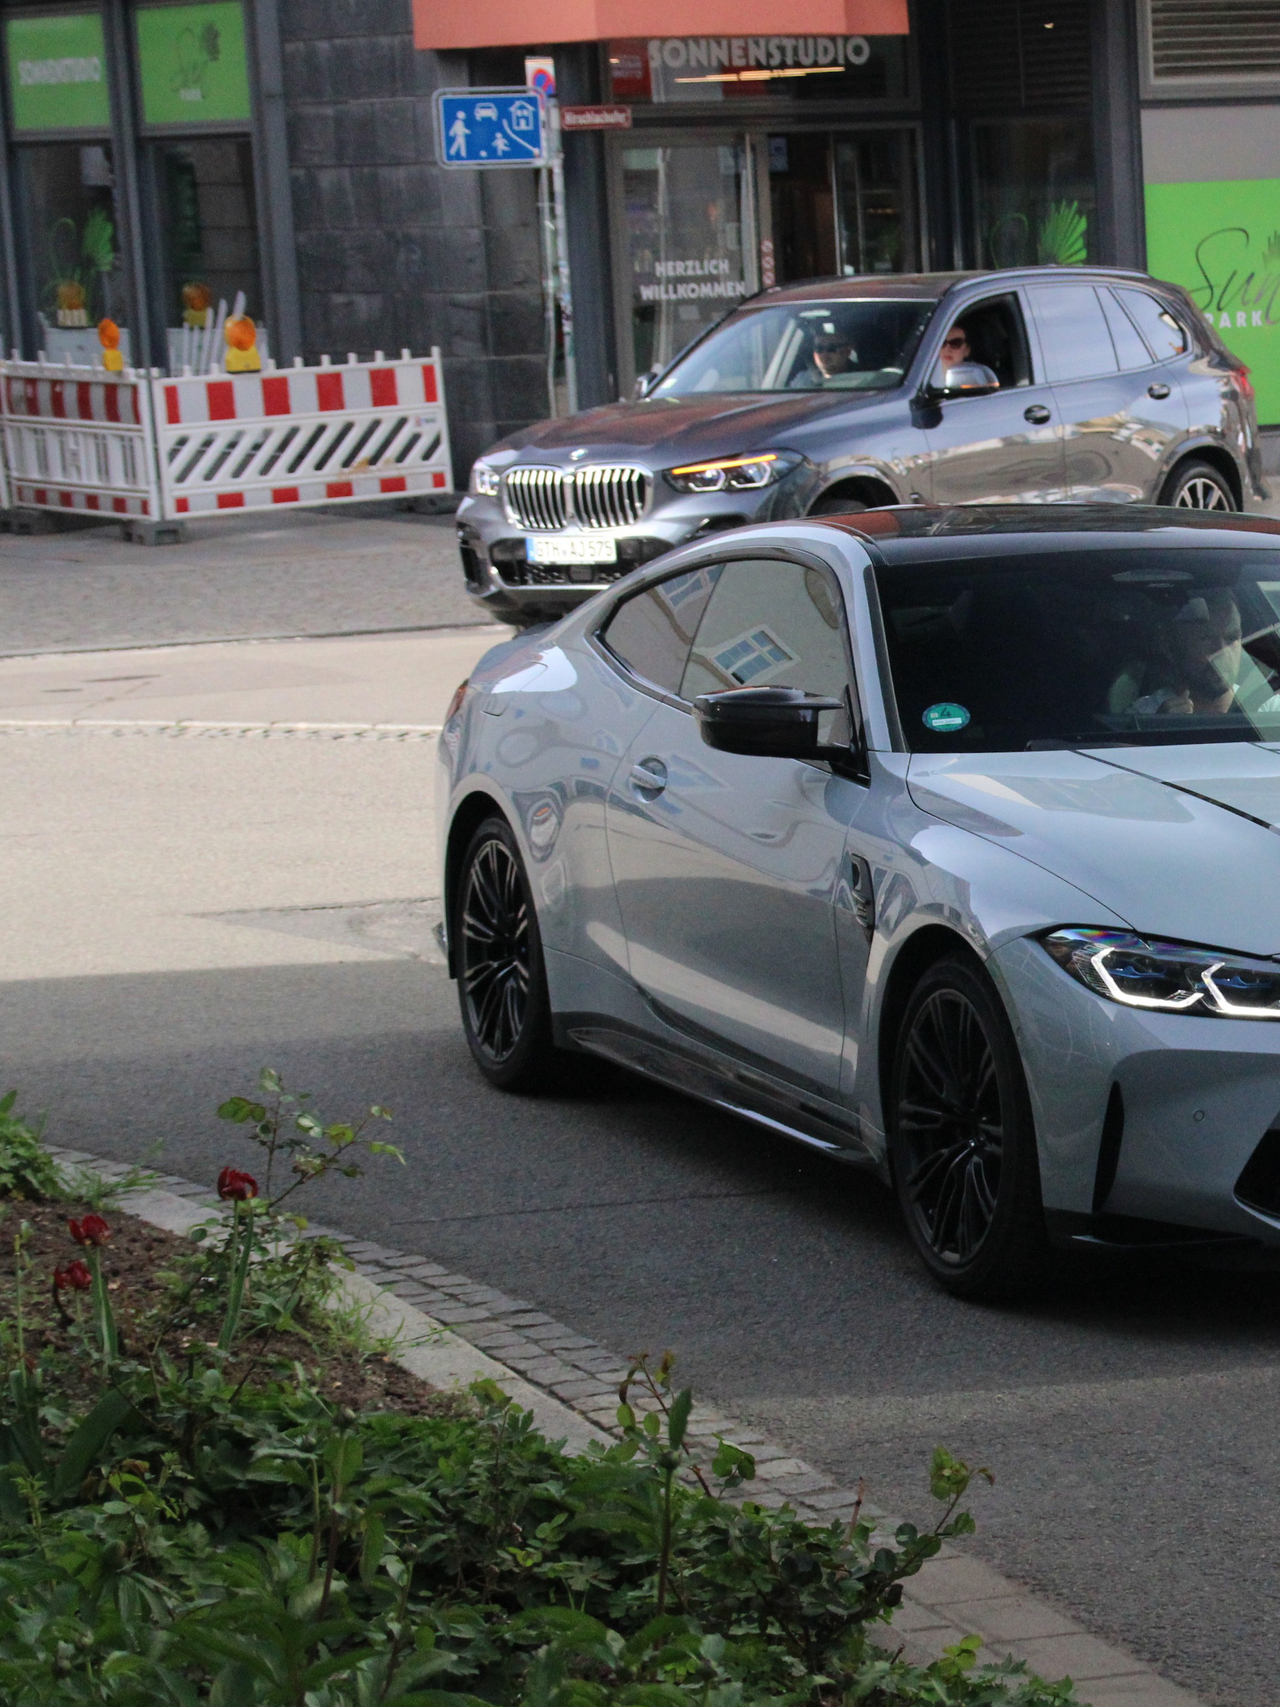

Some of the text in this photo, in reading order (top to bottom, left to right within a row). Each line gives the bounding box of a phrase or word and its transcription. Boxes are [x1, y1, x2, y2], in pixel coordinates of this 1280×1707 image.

[648, 36, 870, 69] SONNENSTUDIO
[655, 259, 730, 277] HERZLICH
[640, 281, 746, 300] WILLKOMMEN
[536, 541, 560, 557] GTH
[588, 541, 613, 557] 575
